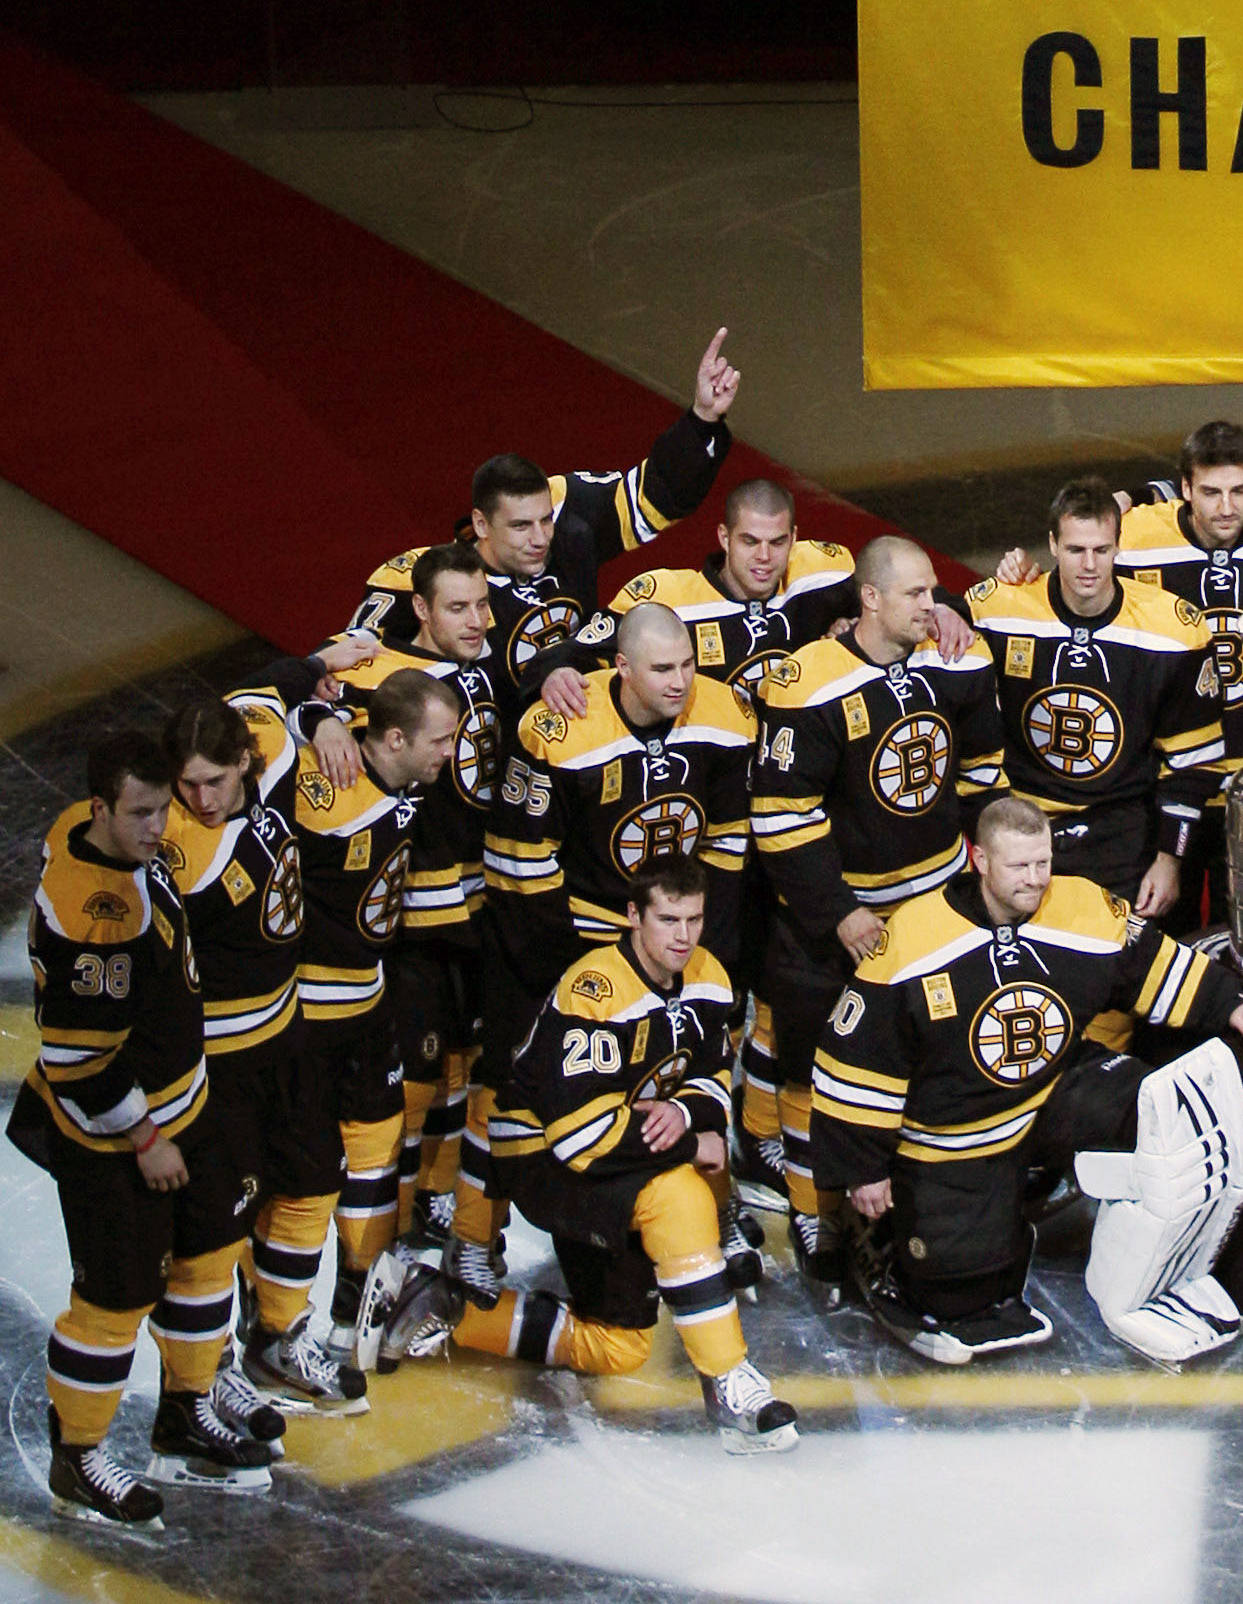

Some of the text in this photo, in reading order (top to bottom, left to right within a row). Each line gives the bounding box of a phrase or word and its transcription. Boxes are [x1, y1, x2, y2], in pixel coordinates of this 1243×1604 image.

[1049, 706, 1095, 761] B
[502, 756, 552, 816] 55
[899, 737, 935, 795] B
[71, 953, 132, 999] 38
[563, 1028, 622, 1077] 20
[999, 1007, 1046, 1066] B
